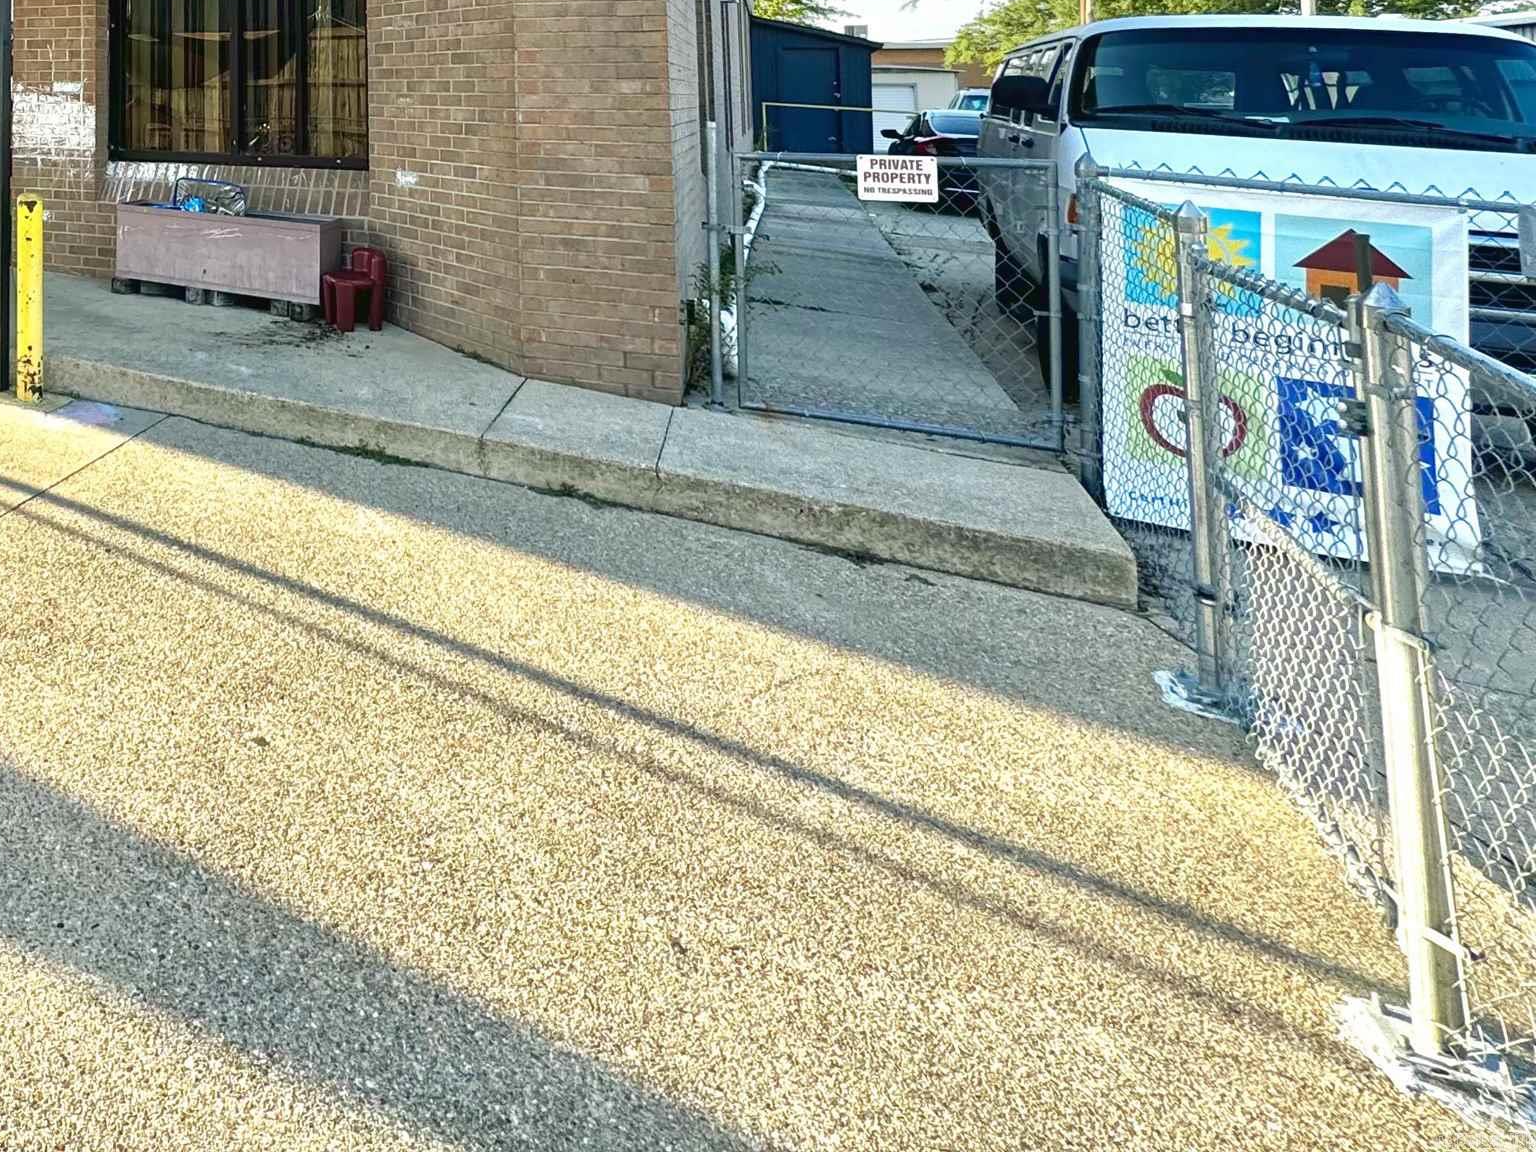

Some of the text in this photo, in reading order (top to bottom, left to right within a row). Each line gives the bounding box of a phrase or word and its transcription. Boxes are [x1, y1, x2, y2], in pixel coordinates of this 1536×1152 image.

[870, 159, 923, 171] PRIVATE
[863, 171, 932, 185] PROPERTY
[878, 187, 933, 196] TRESPASSING
